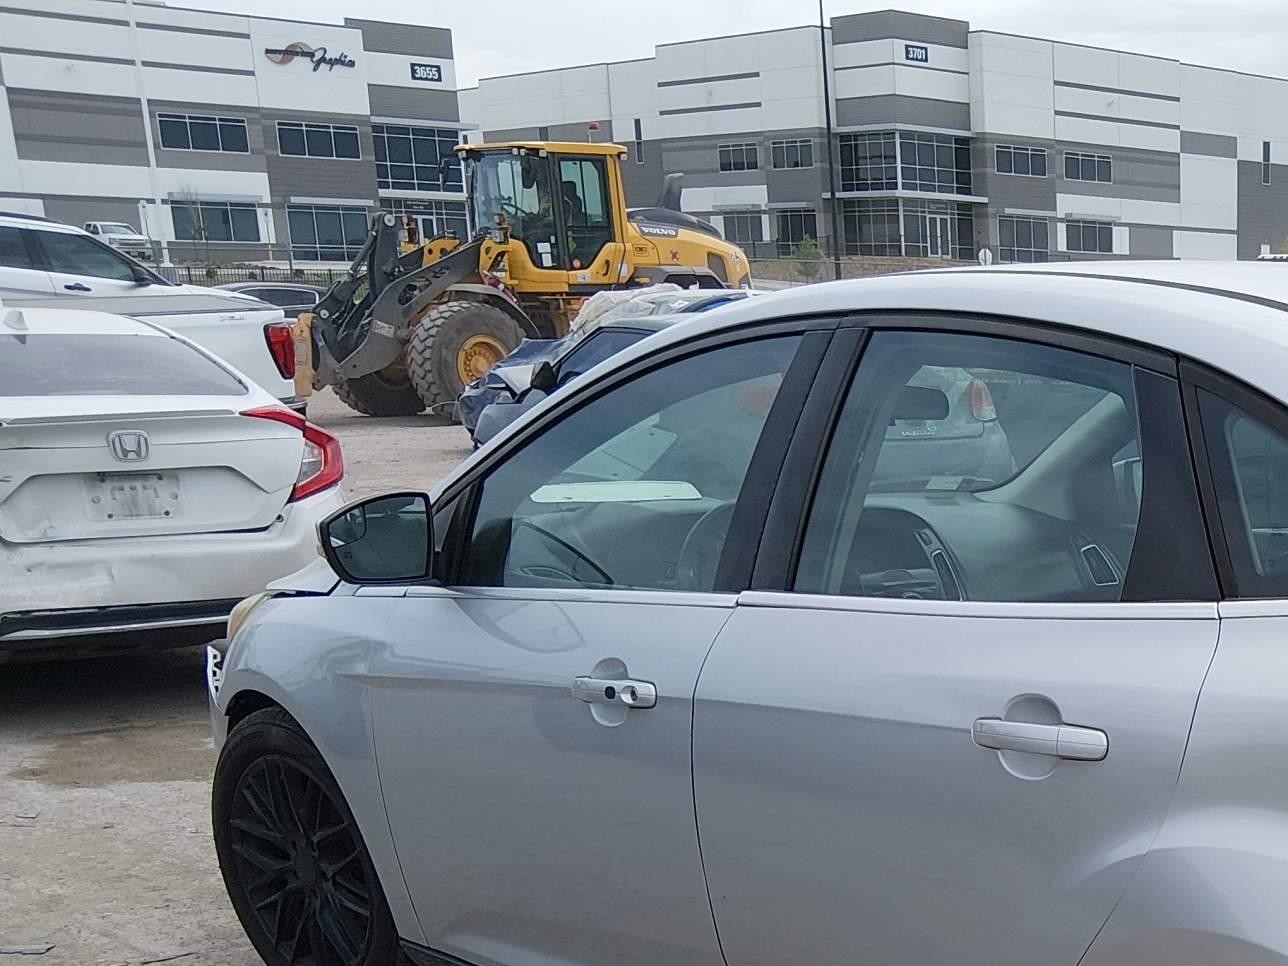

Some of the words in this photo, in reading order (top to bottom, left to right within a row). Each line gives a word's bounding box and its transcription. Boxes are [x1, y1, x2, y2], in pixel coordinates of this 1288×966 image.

[907, 47, 926, 60] 3701
[414, 66, 439, 80] 3655
[641, 227, 676, 236] VOLVO
